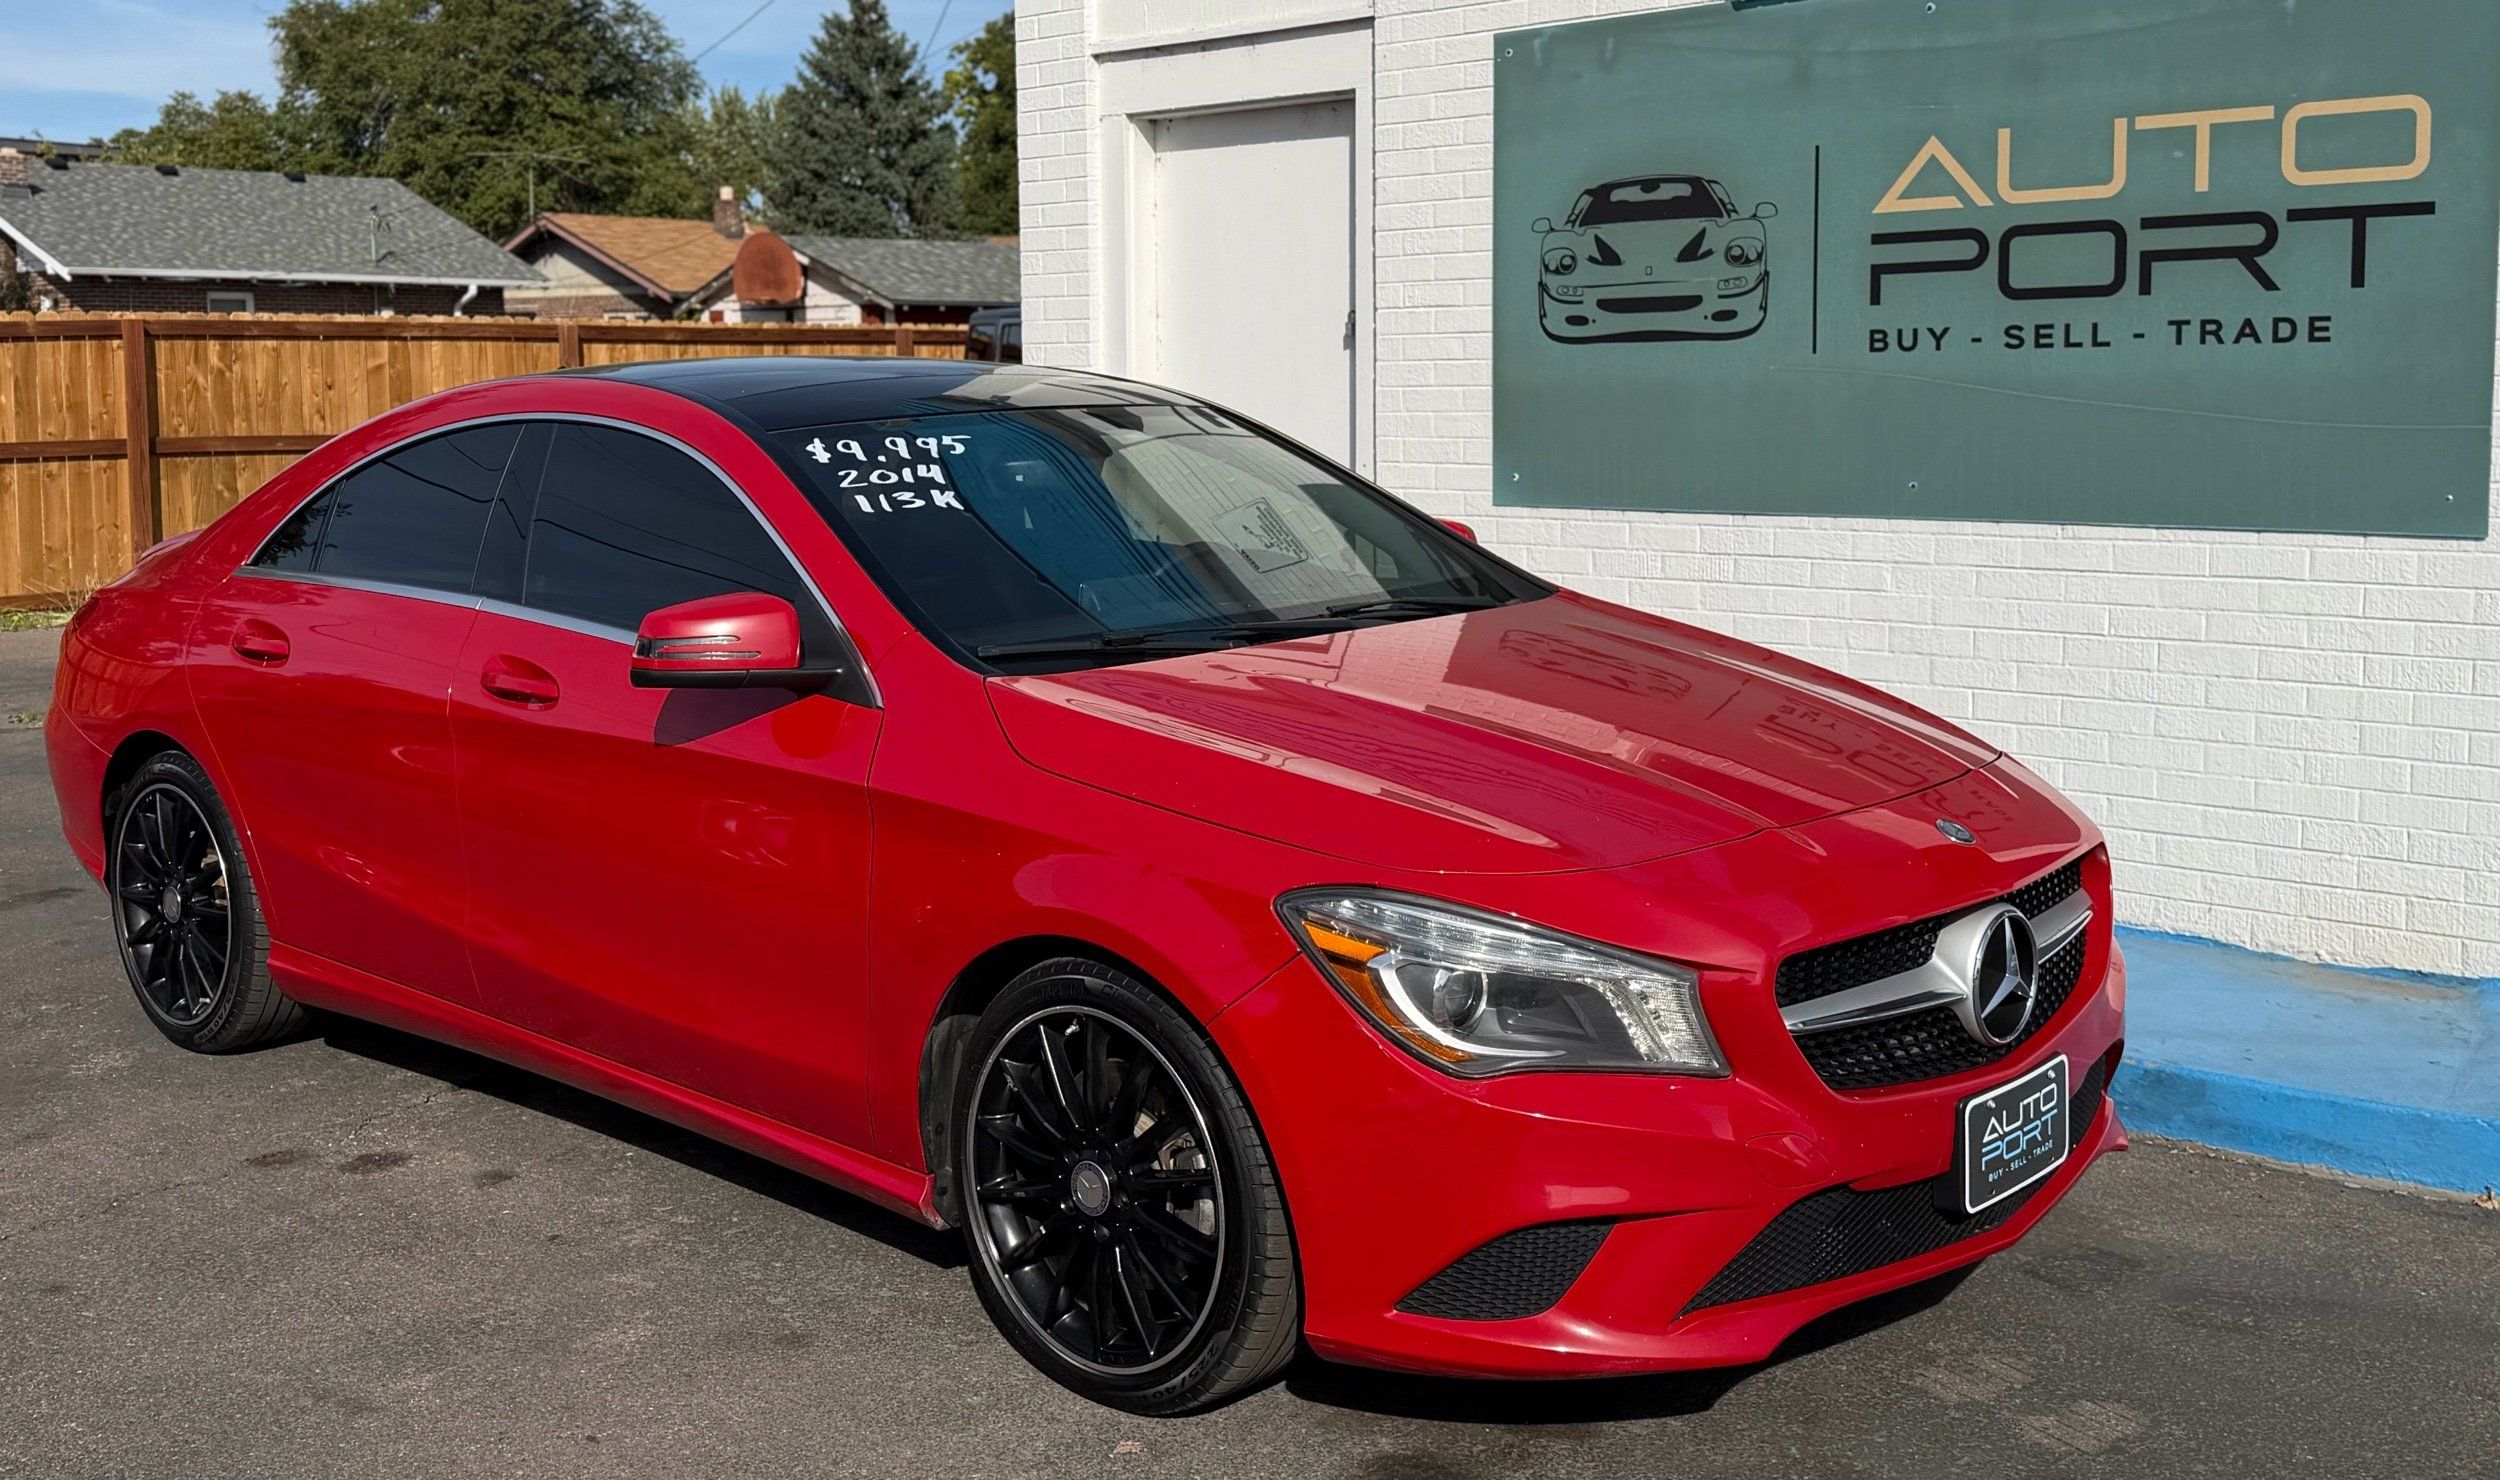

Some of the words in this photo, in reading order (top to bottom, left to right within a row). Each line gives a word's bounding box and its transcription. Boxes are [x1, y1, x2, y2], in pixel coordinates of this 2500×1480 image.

[1872, 93, 2432, 213] AUTO
[1871, 201, 2436, 306] PORT
[1868, 326, 1951, 352] BUY
[2003, 322, 2112, 350] SELL
[2168, 315, 2333, 347] TRADE
[837, 464, 946, 488] 2014
[1981, 1108, 2058, 1171] PORT
[1982, 1082, 2057, 1143] AUTO
[1988, 1168, 2003, 1182] BUY
[2010, 1155, 2027, 1171] SELL
[2033, 1139, 2053, 1157] TRADE
